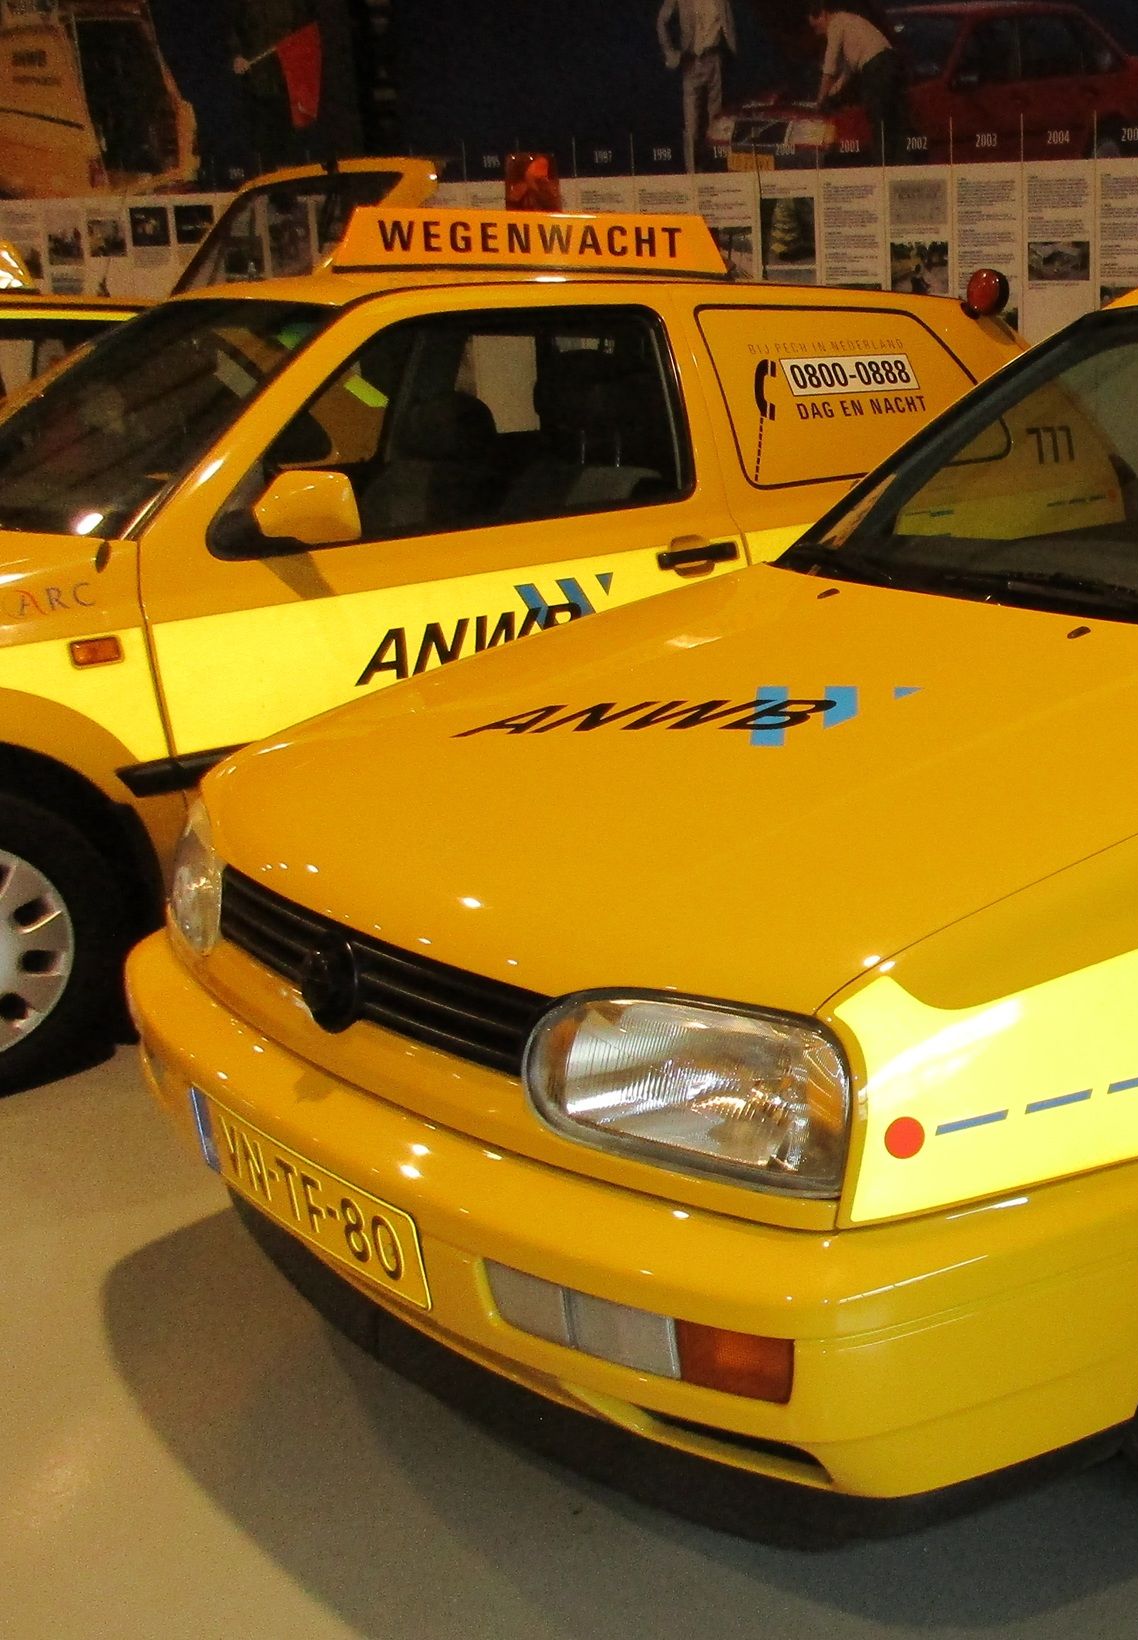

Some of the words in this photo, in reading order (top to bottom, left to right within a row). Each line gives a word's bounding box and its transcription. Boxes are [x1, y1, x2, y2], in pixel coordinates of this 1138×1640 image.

[840, 139, 860, 153] 2001
[906, 136, 928, 150] 2002
[975, 133, 998, 148] 2003
[1047, 130, 1070, 145] 2004
[378, 219, 682, 258] WEGENWACHT
[748, 344, 770, 355] BIJ
[775, 342, 807, 354] PECH
[812, 340, 827, 352] IN
[830, 338, 904, 351] NEDERLAND
[789, 359, 911, 389] 0800-0888
[796, 401, 835, 419] DAG
[840, 399, 864, 417] EN
[870, 395, 926, 415] NACHT
[1, 581, 96, 620] ARC
[450, 699, 837, 738] ANWB
[218, 1114, 405, 1281] VN-TF-80
